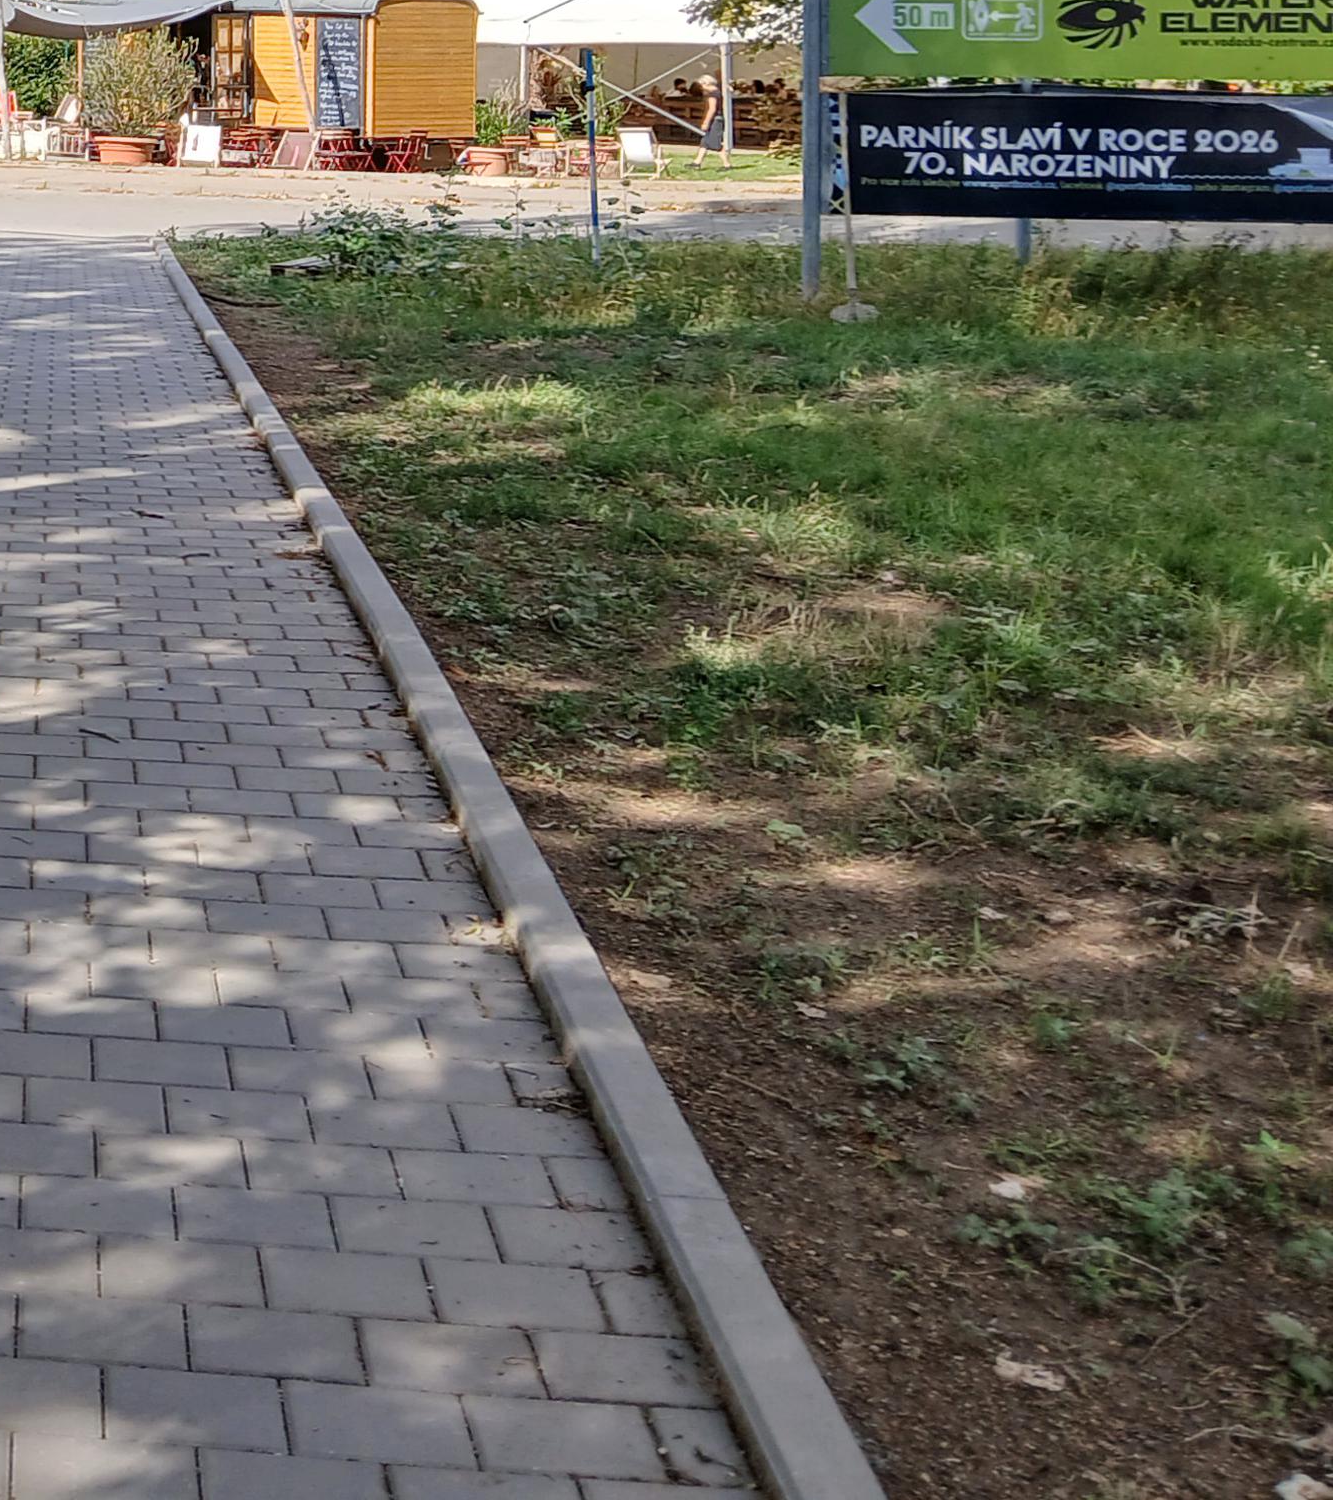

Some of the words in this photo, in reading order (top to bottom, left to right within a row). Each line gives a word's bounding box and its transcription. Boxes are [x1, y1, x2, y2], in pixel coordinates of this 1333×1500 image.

[893, 4, 923, 28] 50
[930, 9, 951, 28] m
[860, 120, 975, 149] PARNÍK
[980, 122, 1063, 150] SLAVÍ
[1068, 128, 1092, 150] V
[1098, 128, 1187, 152] ROCE
[1194, 129, 1279, 153] 2026
[903, 151, 955, 175] 70.
[963, 152, 1177, 178] NAROZENINY
